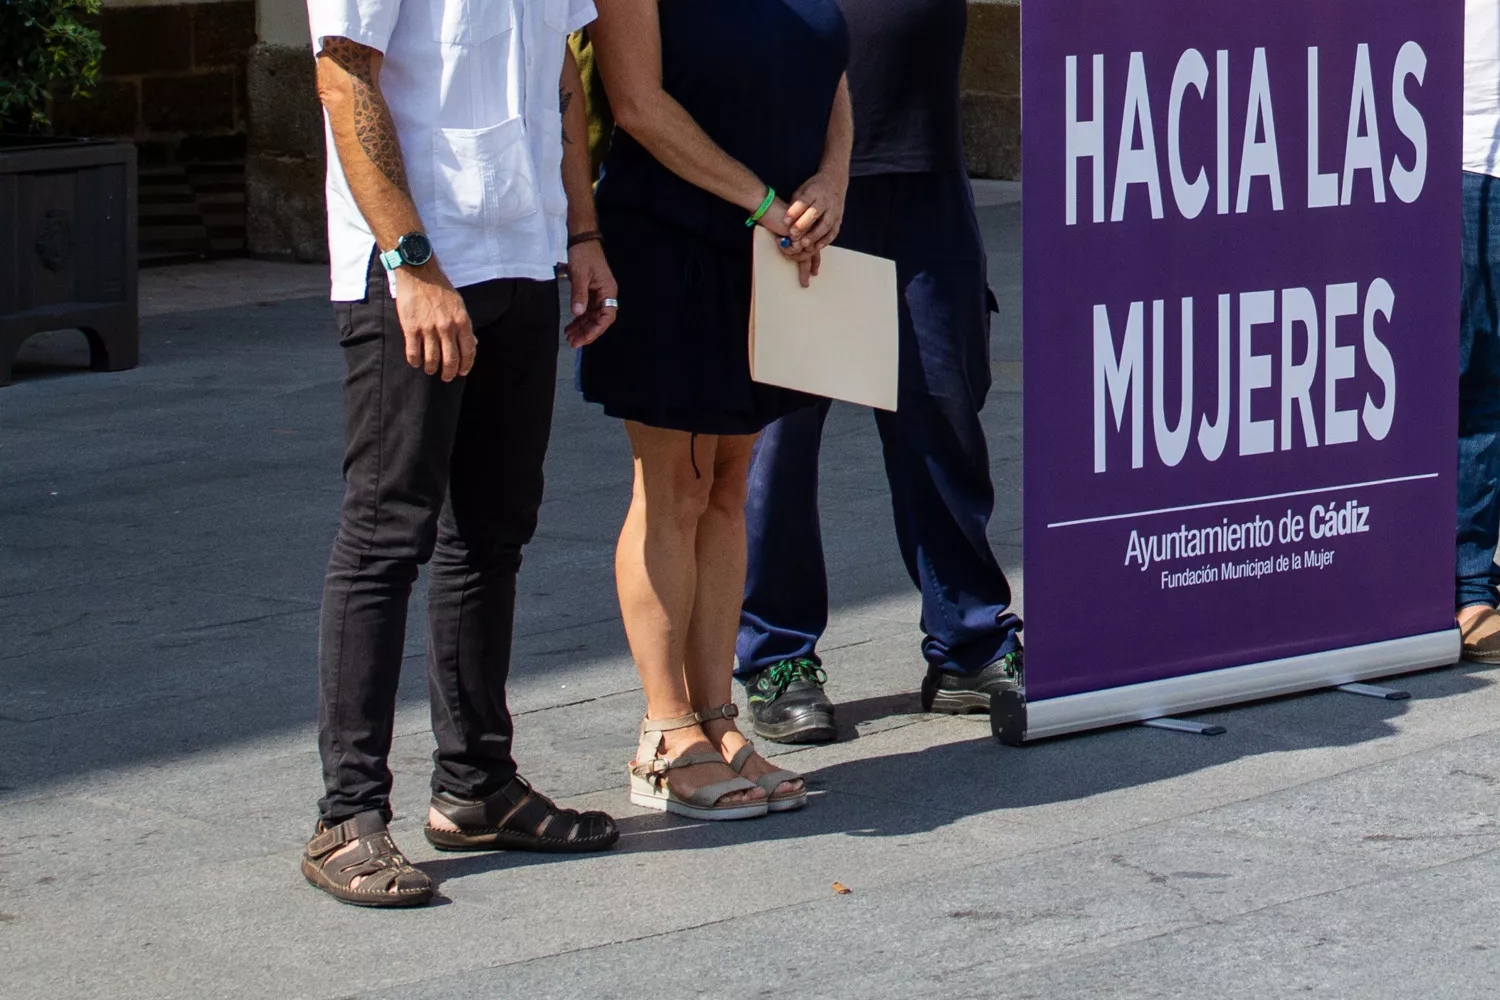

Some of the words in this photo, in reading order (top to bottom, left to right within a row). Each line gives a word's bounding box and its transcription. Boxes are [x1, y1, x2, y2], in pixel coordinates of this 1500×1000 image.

[1065, 47, 1284, 226] HACIA
[1307, 40, 1428, 209] LAS
[1093, 277, 1396, 474] MUJERES
[1124, 514, 1274, 572] Ayuntamiento
[1278, 509, 1305, 544] de
[1309, 499, 1370, 540] Cádiz
[1161, 564, 1219, 590] Fundación
[1221, 556, 1274, 580] Municipal
[1275, 554, 1290, 573] de
[1291, 552, 1302, 570] la
[1304, 549, 1335, 570] Mujer
